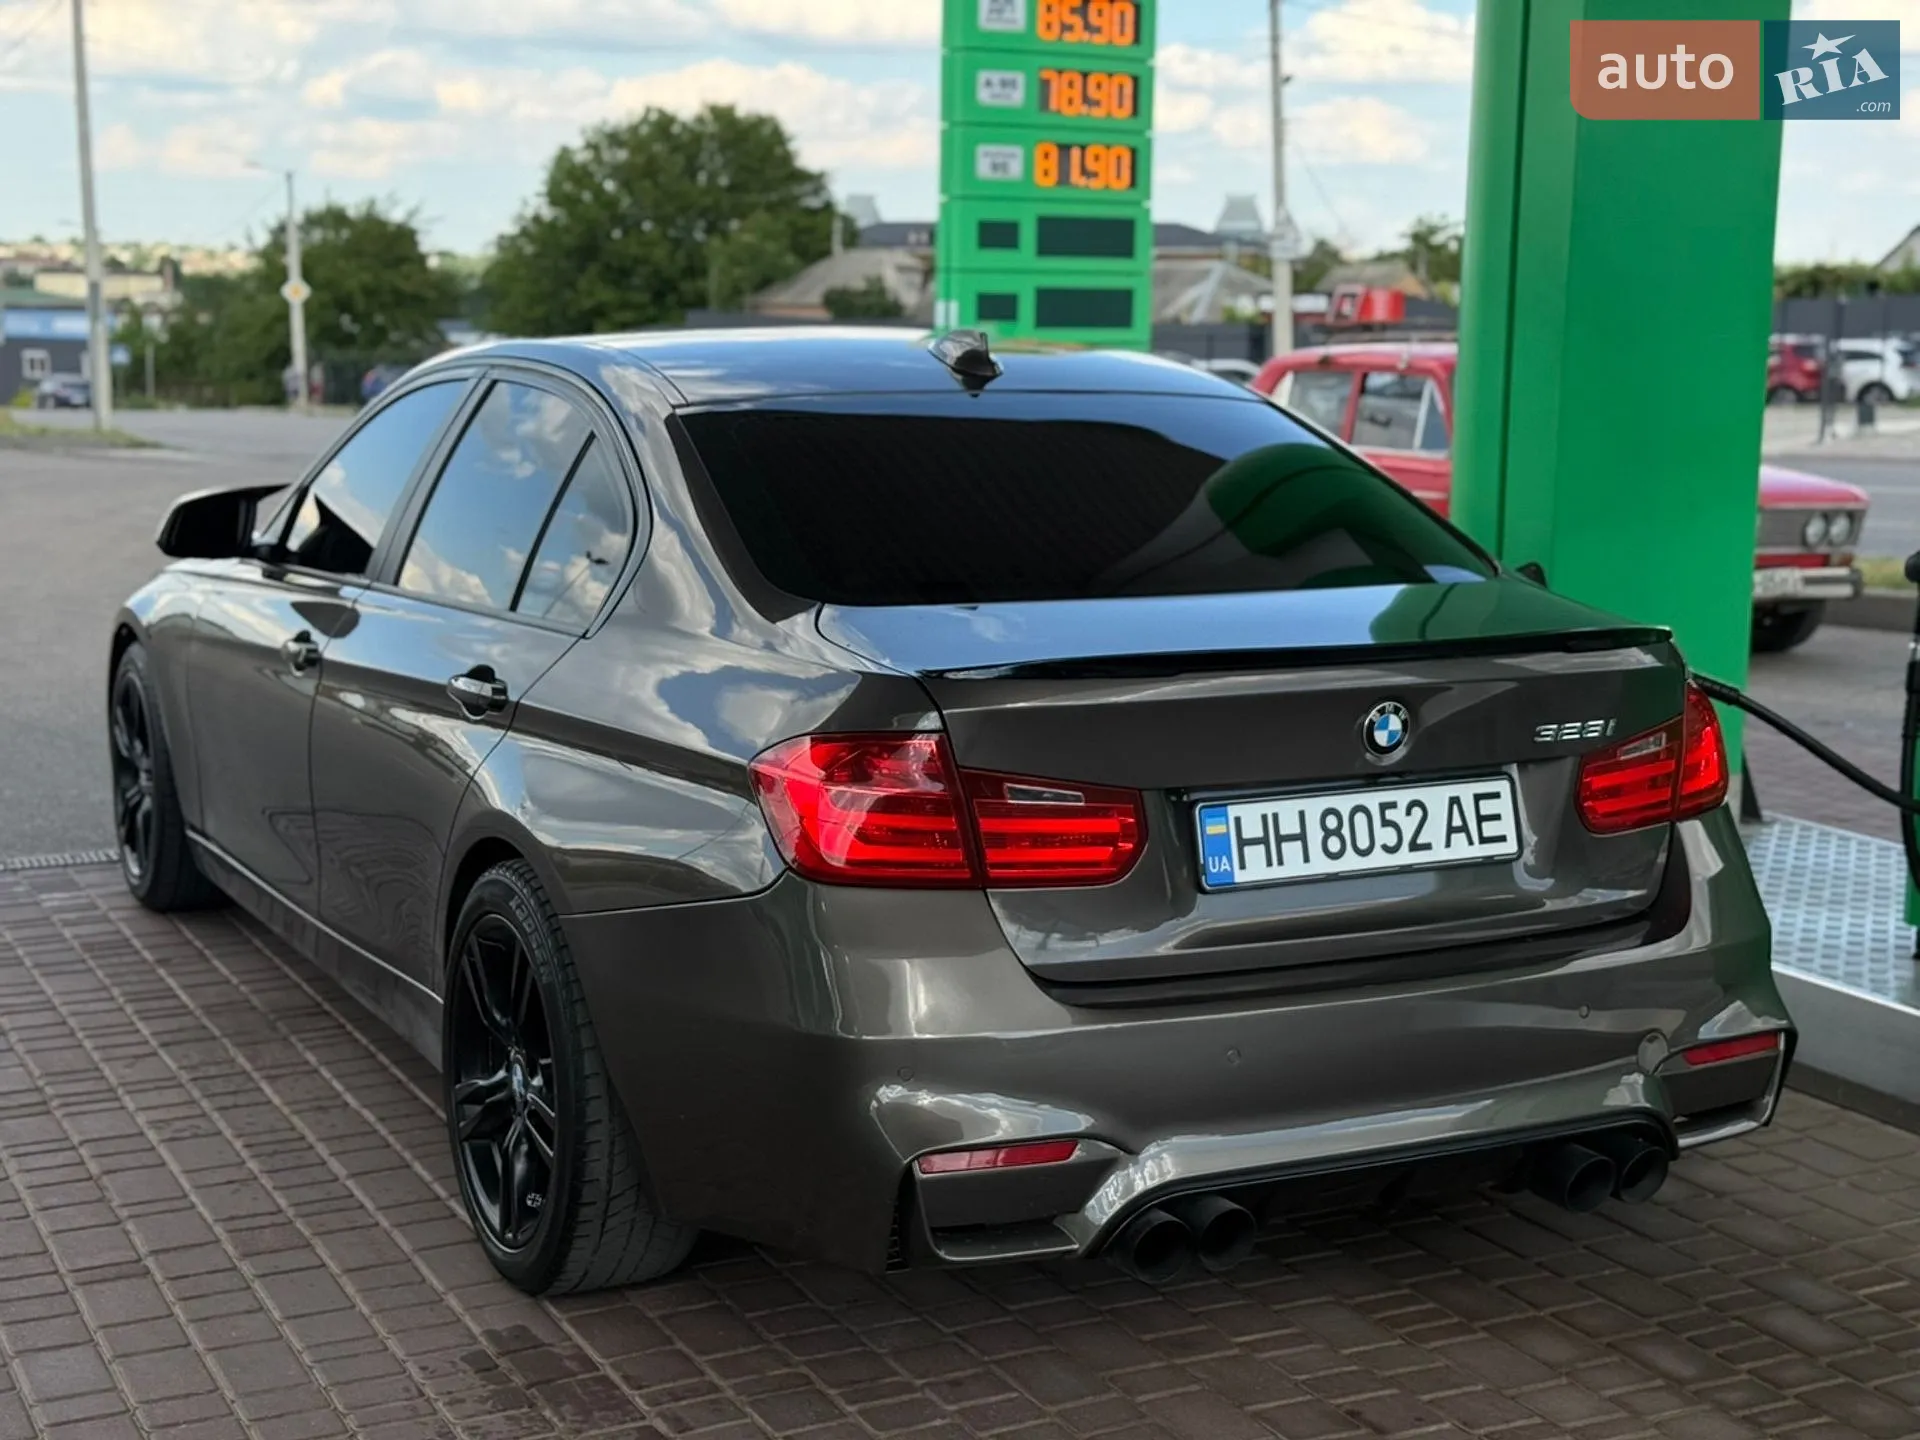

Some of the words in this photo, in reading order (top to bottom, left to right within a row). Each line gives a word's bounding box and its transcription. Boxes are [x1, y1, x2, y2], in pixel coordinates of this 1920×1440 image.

[1038, 68, 1133, 119] 78.90
[1233, 809, 1311, 871] HH
[1319, 800, 1433, 861] 8052
[1444, 791, 1508, 849] AE
[1208, 855, 1231, 874] UA
